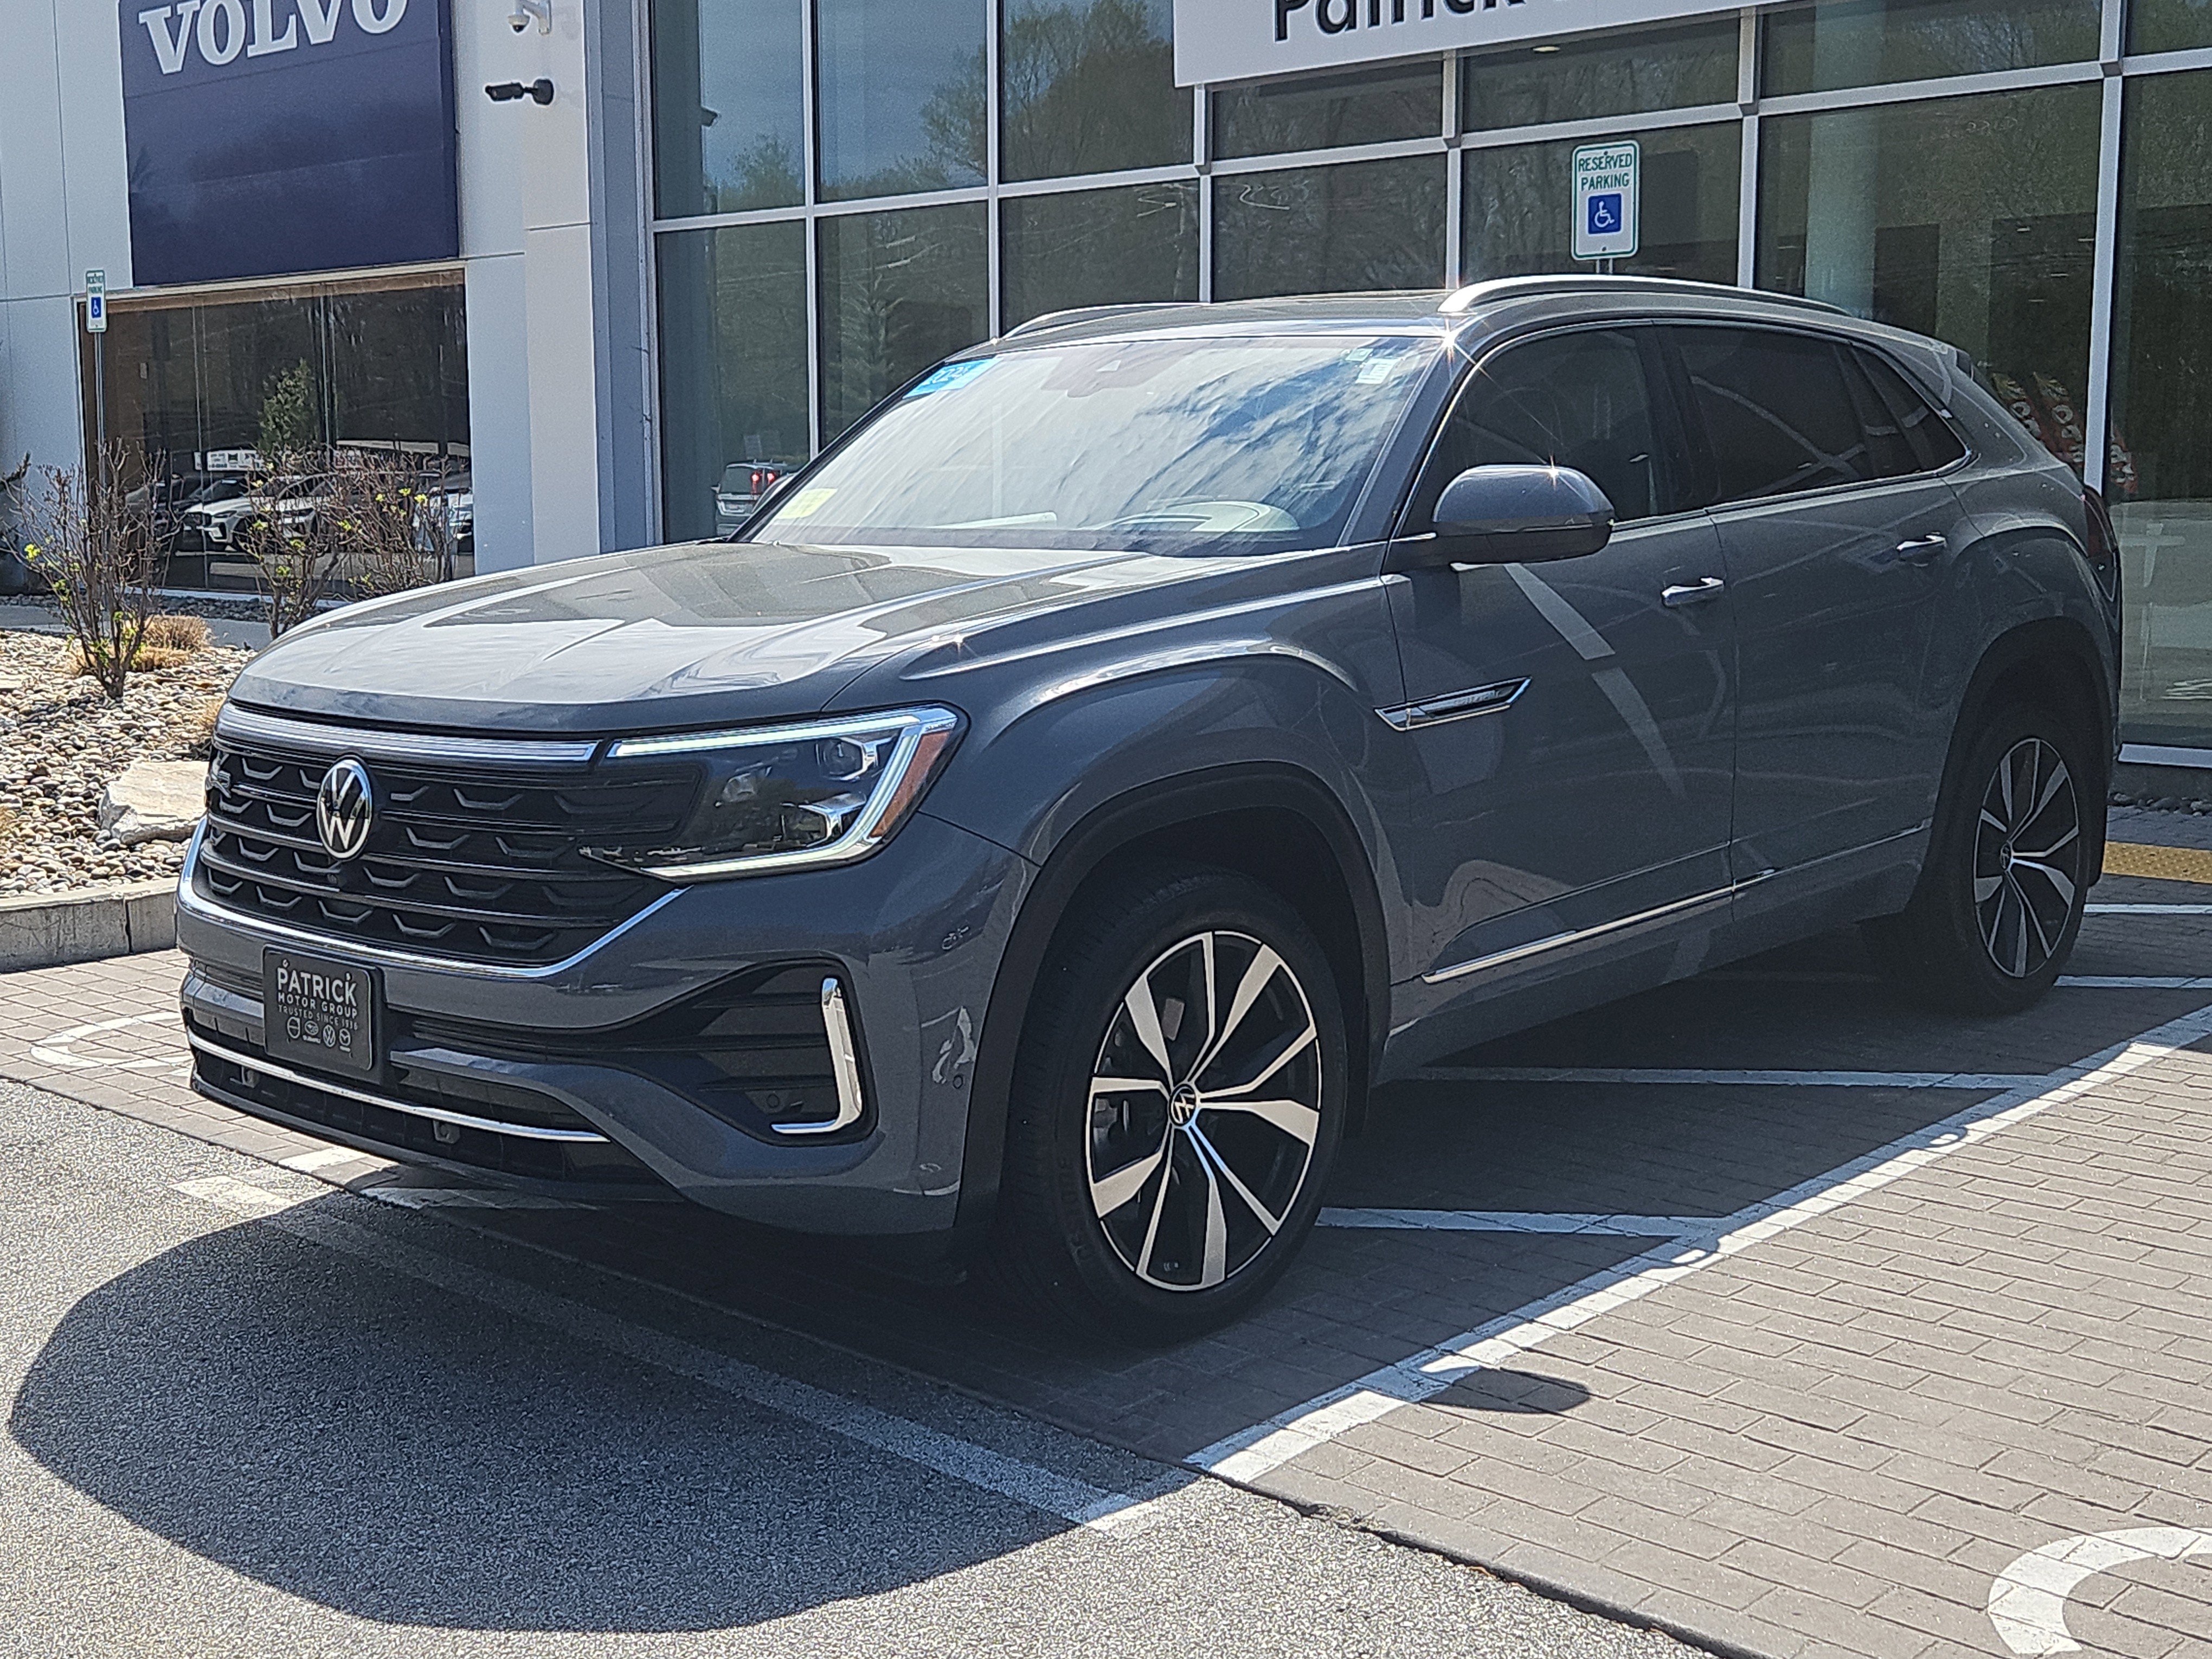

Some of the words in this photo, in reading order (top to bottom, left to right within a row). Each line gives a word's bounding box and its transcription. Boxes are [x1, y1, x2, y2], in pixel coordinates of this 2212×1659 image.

[139, 0, 408, 74] VOLVO
[1578, 153, 1632, 172] RESERVED
[1581, 173, 1630, 191] PARKING
[277, 967, 357, 1007] PATRICK
[278, 992, 316, 1009] MOTOR
[321, 1001, 358, 1019] GROUP
[278, 1005, 313, 1019] TRUSTED
[316, 1012, 339, 1026] SINCE
